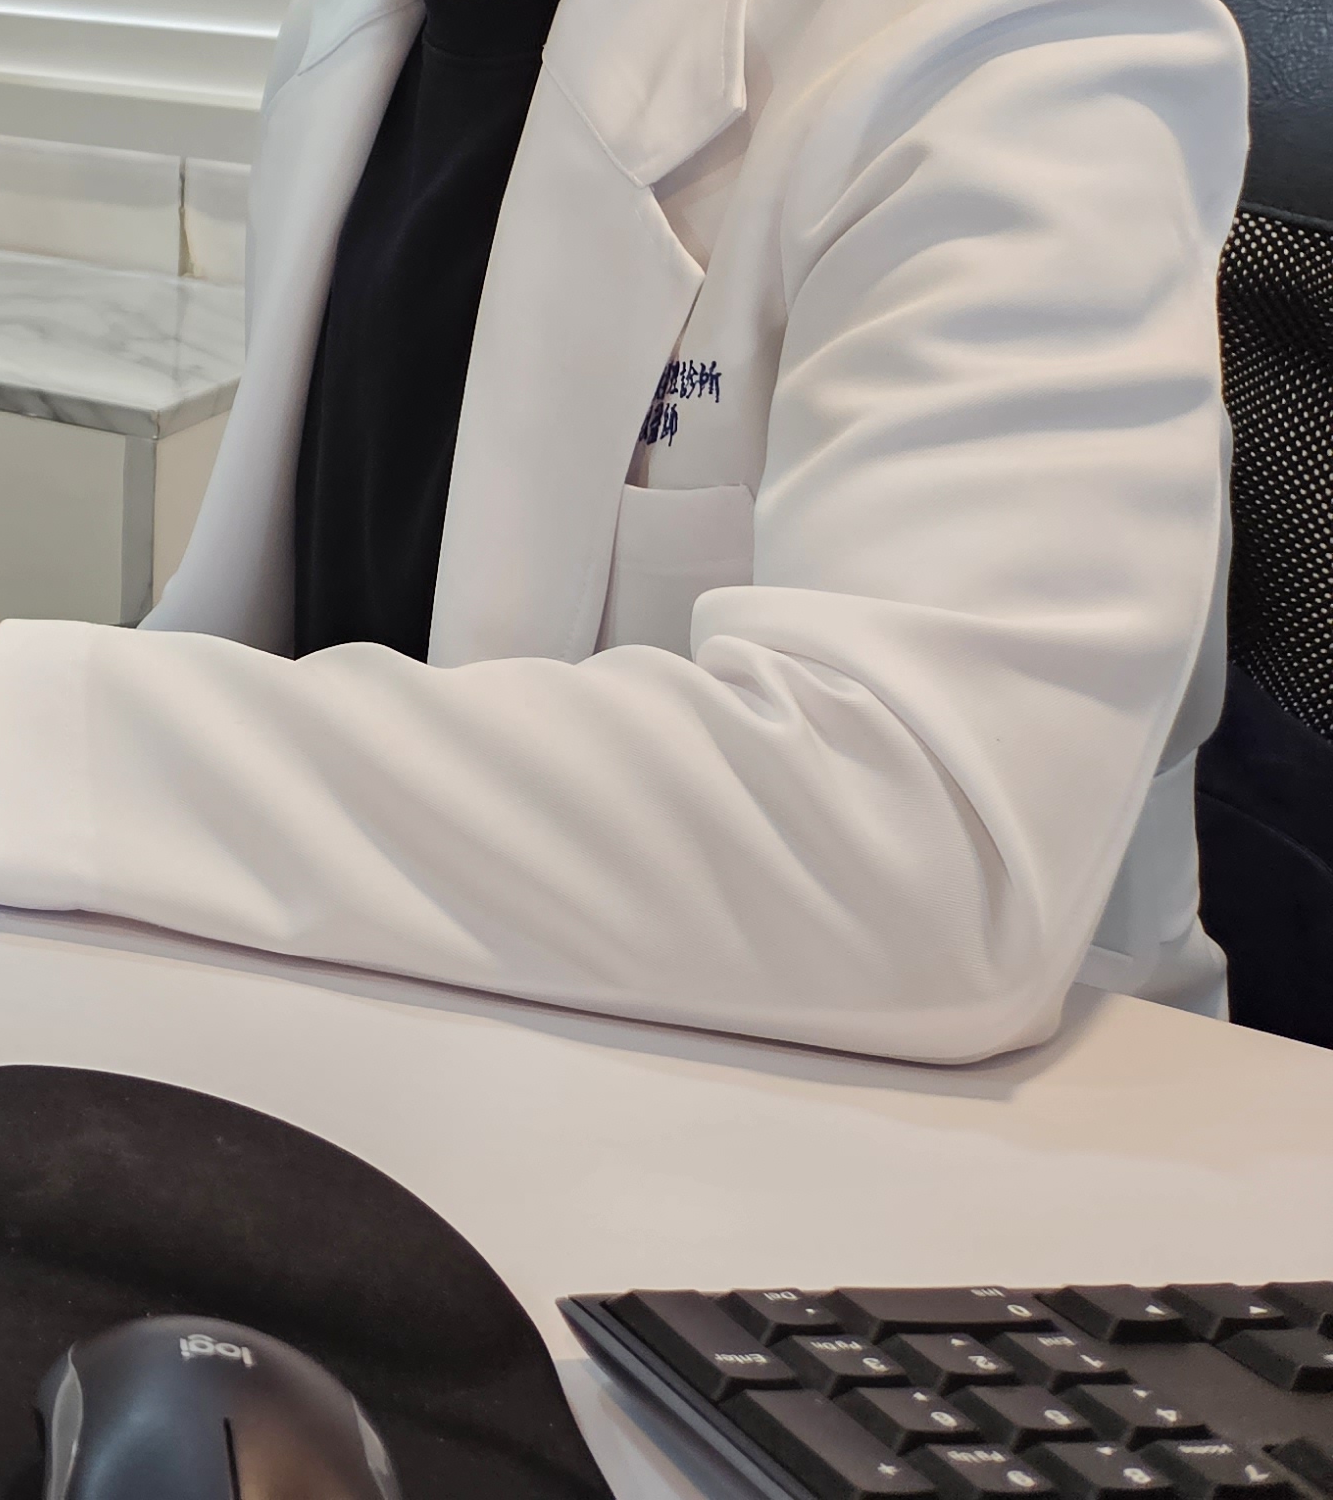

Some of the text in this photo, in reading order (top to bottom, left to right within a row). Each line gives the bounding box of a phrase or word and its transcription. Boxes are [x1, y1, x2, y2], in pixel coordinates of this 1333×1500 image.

[179, 1333, 253, 1366] logi
[714, 1352, 769, 1365] Enter
[968, 1354, 999, 1371] 2
